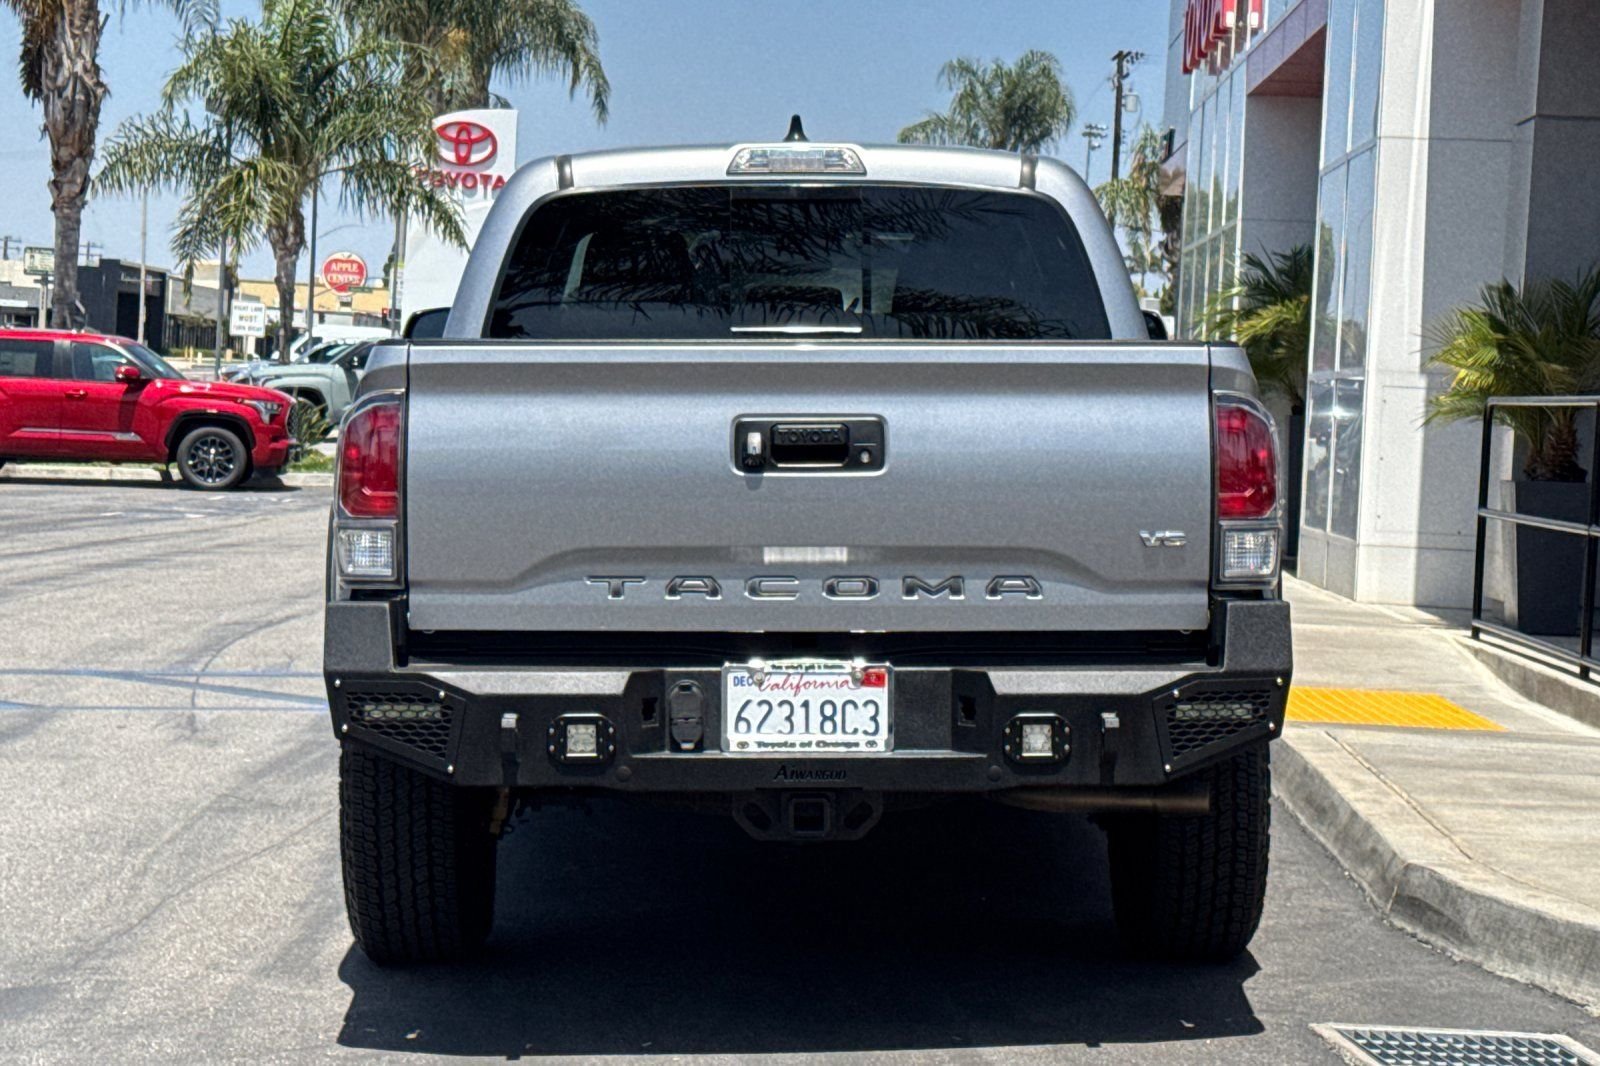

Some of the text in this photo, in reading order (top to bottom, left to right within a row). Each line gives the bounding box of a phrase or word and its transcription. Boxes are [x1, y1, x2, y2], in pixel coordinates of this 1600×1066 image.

[330, 262, 359, 272] APPLE
[238, 314, 257, 323] MUST
[778, 429, 842, 443] TOYOTA
[1139, 530, 1187, 547] V6
[584, 575, 1043, 600] TACOMA
[733, 677, 753, 687] DEC
[758, 674, 861, 697] California
[734, 699, 880, 736] 62318C3
[755, 740, 797, 749] Toyota
